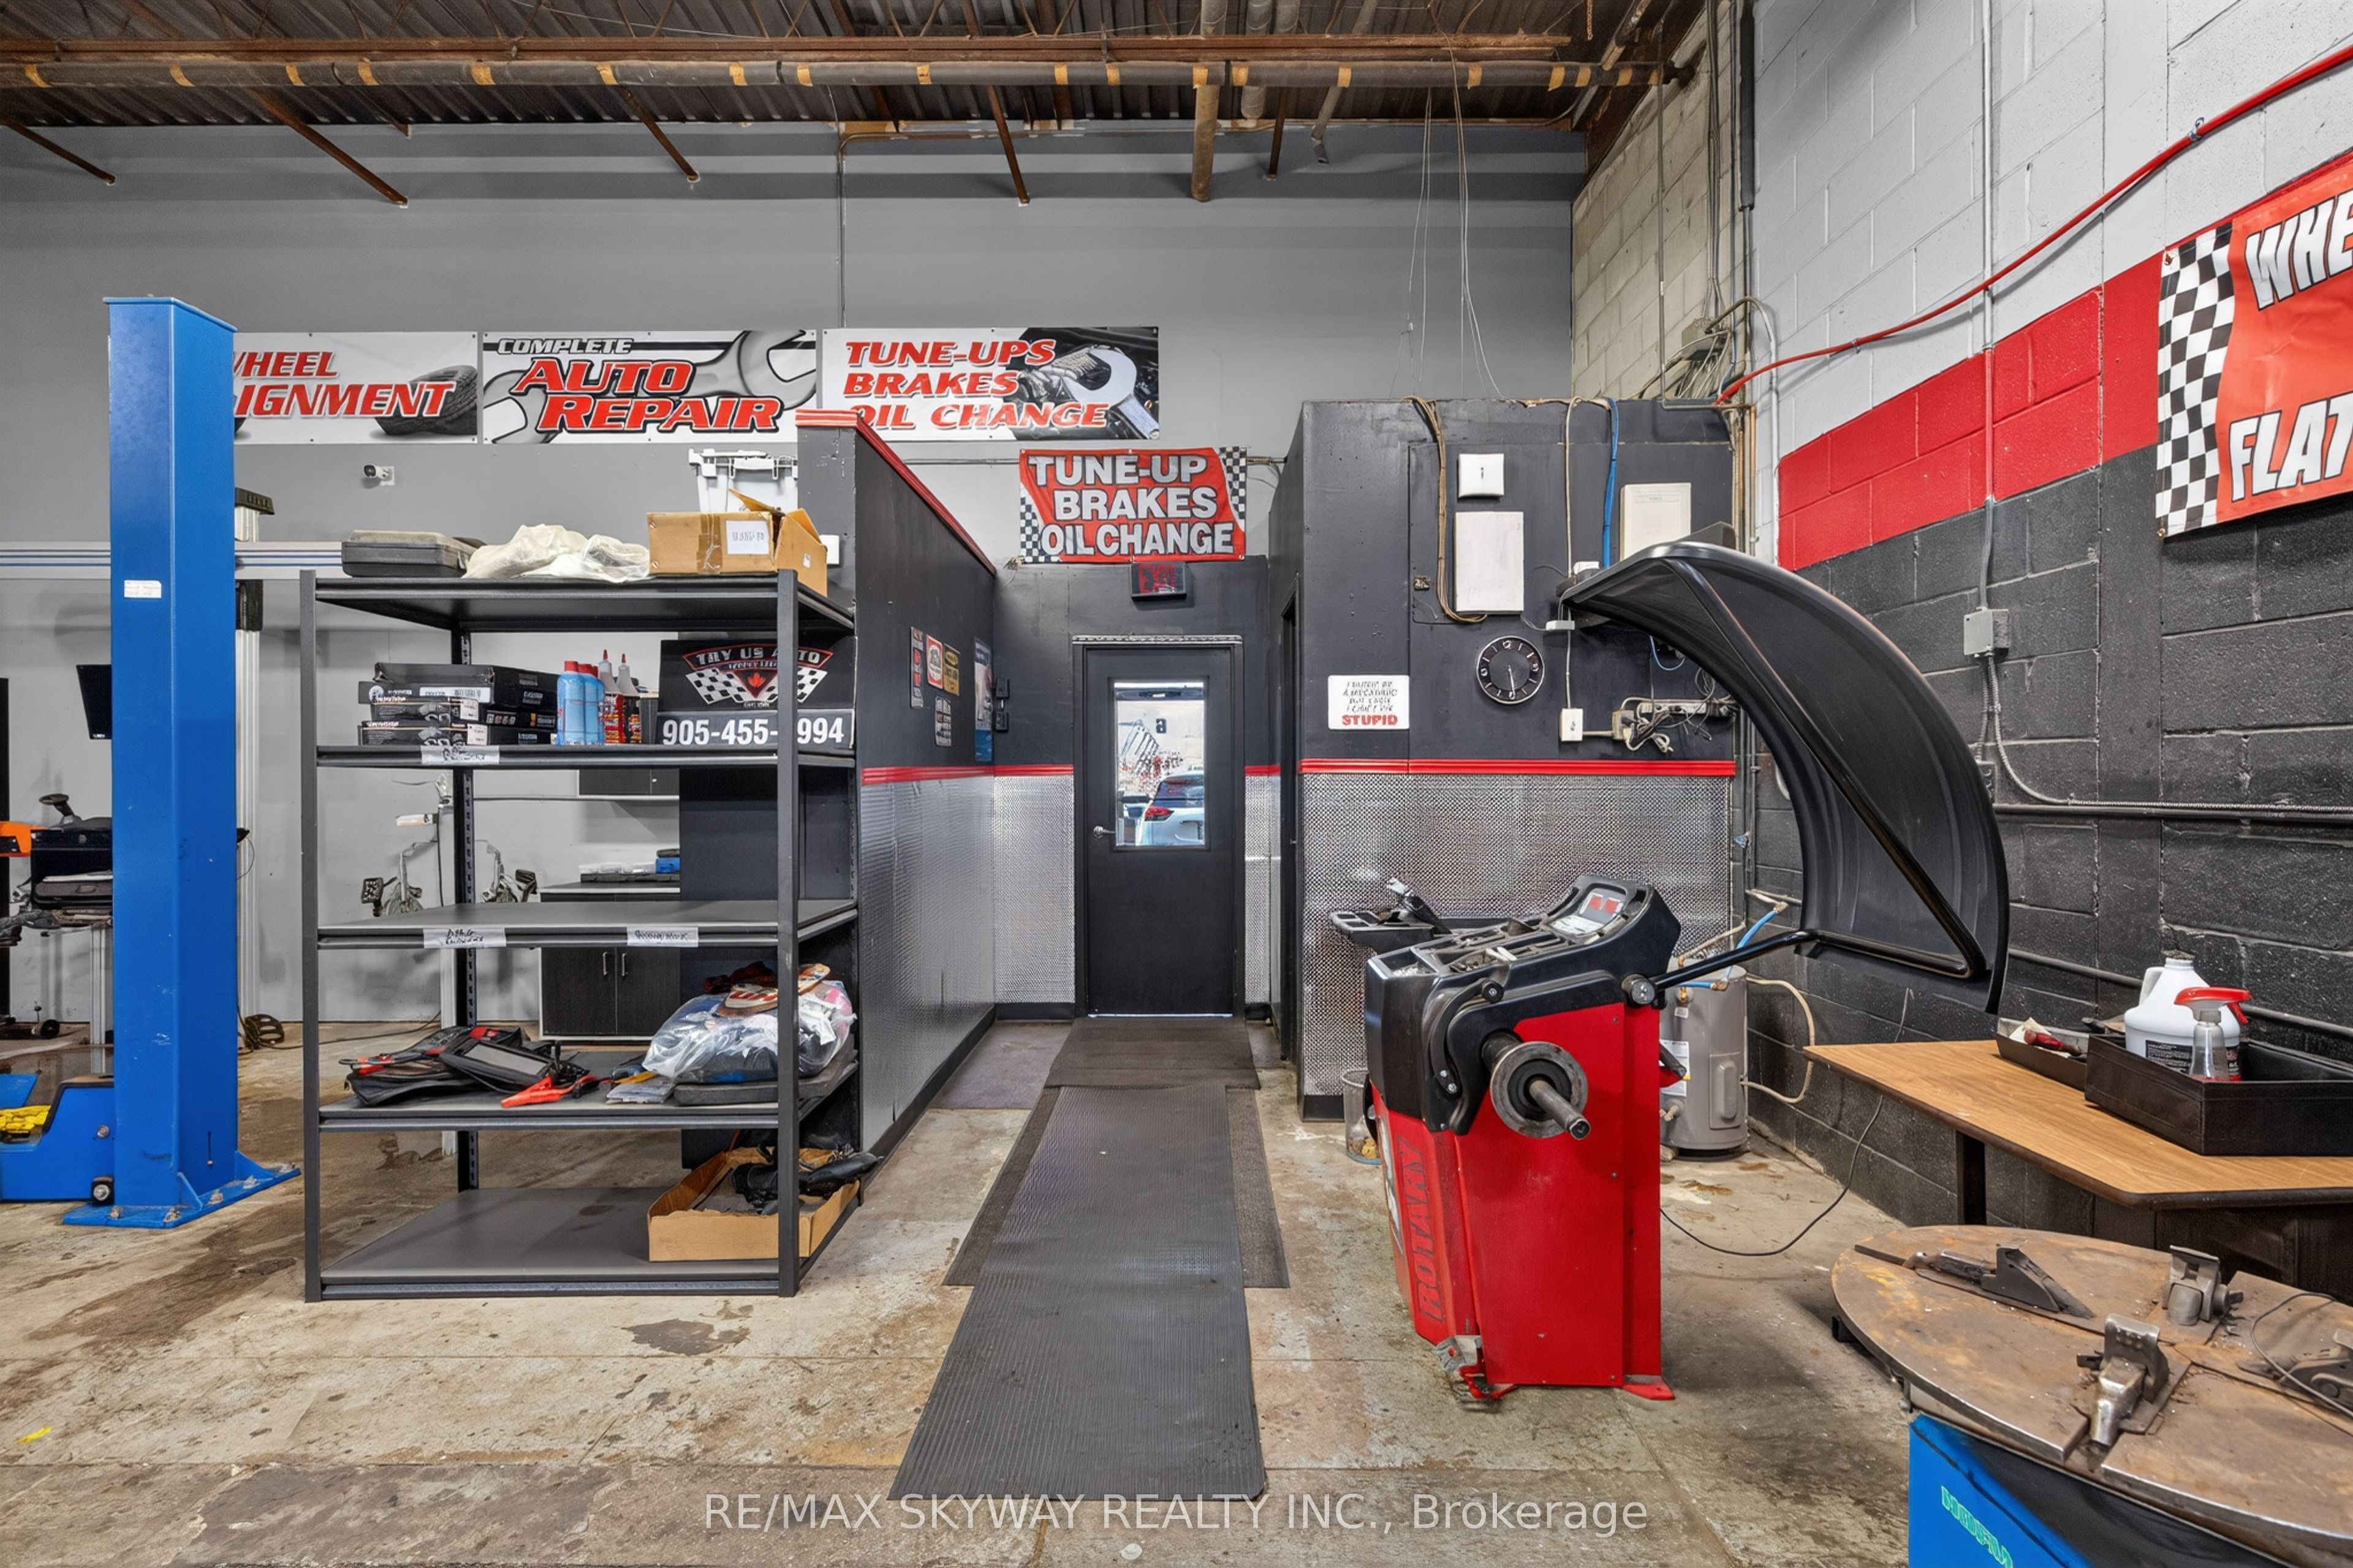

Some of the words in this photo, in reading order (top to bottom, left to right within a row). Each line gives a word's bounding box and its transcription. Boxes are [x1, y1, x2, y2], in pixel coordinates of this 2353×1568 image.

[497, 338, 634, 354] COMPLETE
[846, 339, 1056, 367] TUNE-UPS
[509, 357, 696, 396] AUTO
[843, 370, 1020, 398] BRAKES
[536, 395, 784, 433] REPAIR
[850, 404, 916, 430] OIL
[931, 402, 1109, 430] CHANGE
[1027, 453, 1207, 486] TUNE-UP
[1052, 487, 1218, 521] BRAKES
[1041, 523, 1094, 556] OIL
[1095, 522, 1235, 556] CHANGE
[740, 648, 763, 659] US
[771, 648, 820, 664] TO
[662, 718, 844, 745] 905-455-994
[1342, 714, 1398, 725] STUPID
[1399, 1136, 1444, 1320] ROTARY
